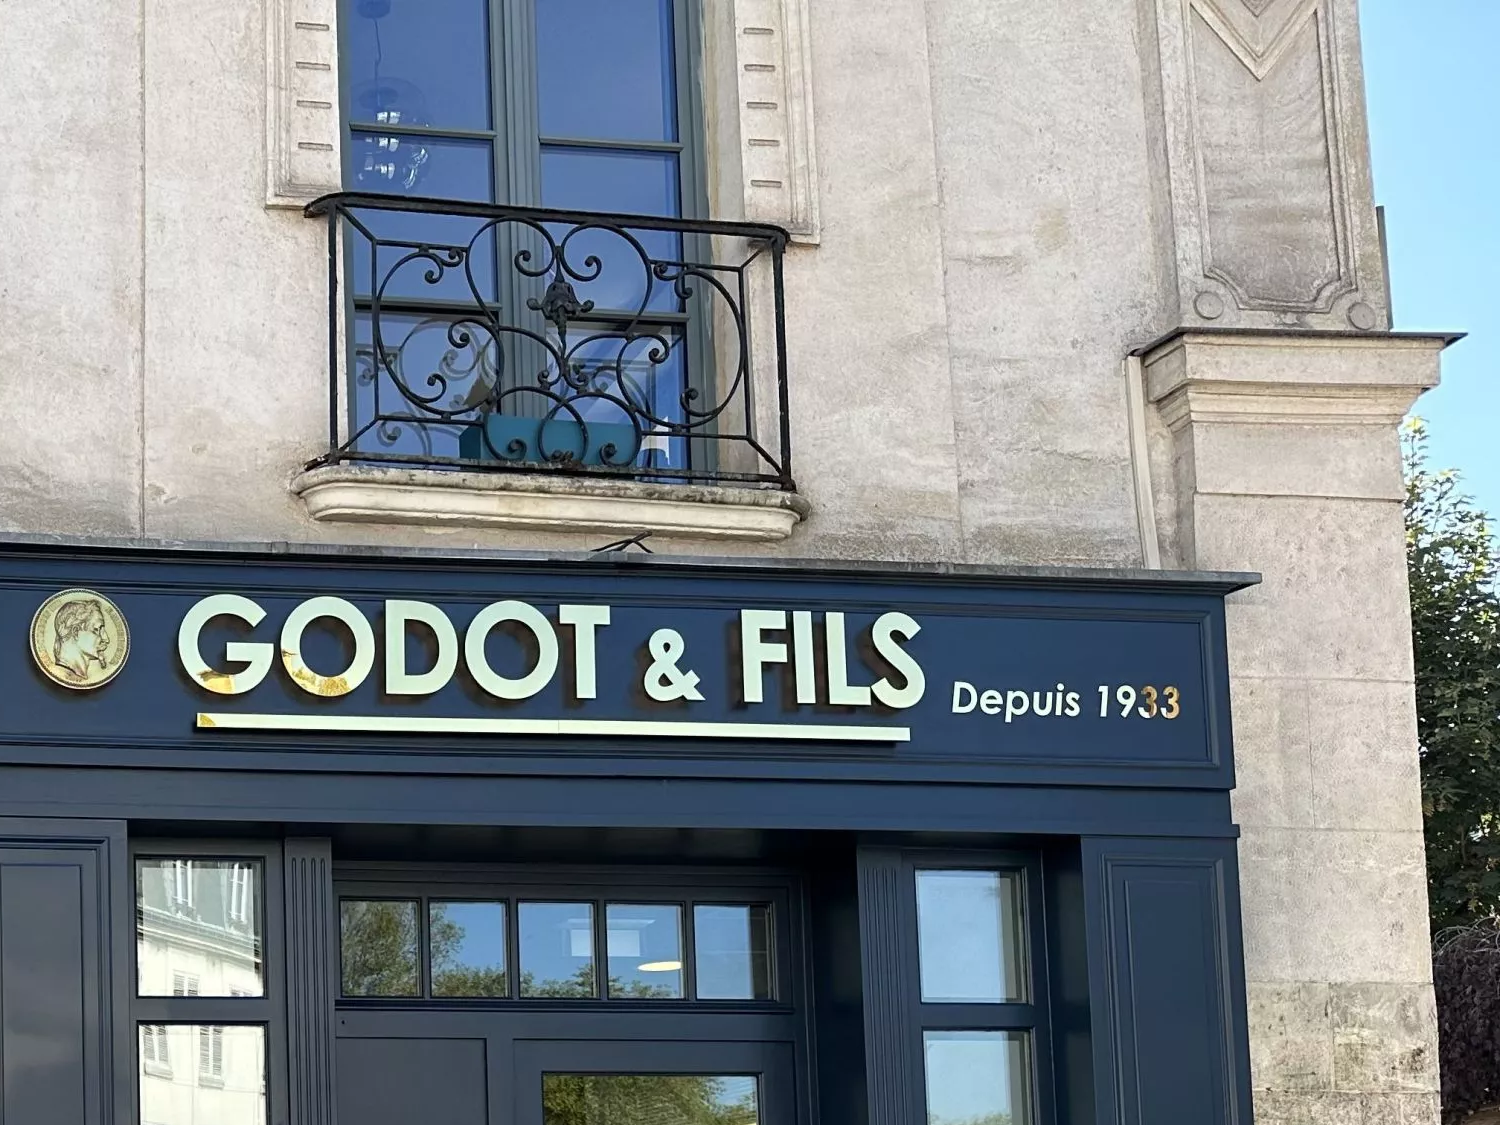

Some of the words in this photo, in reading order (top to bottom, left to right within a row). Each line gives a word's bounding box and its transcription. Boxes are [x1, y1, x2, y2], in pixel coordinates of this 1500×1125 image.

[178, 594, 611, 700] GODOT
[643, 628, 706, 702] &
[741, 609, 926, 709] FILS
[951, 681, 1081, 723] Depuis
[1098, 685, 1181, 719] 1933
